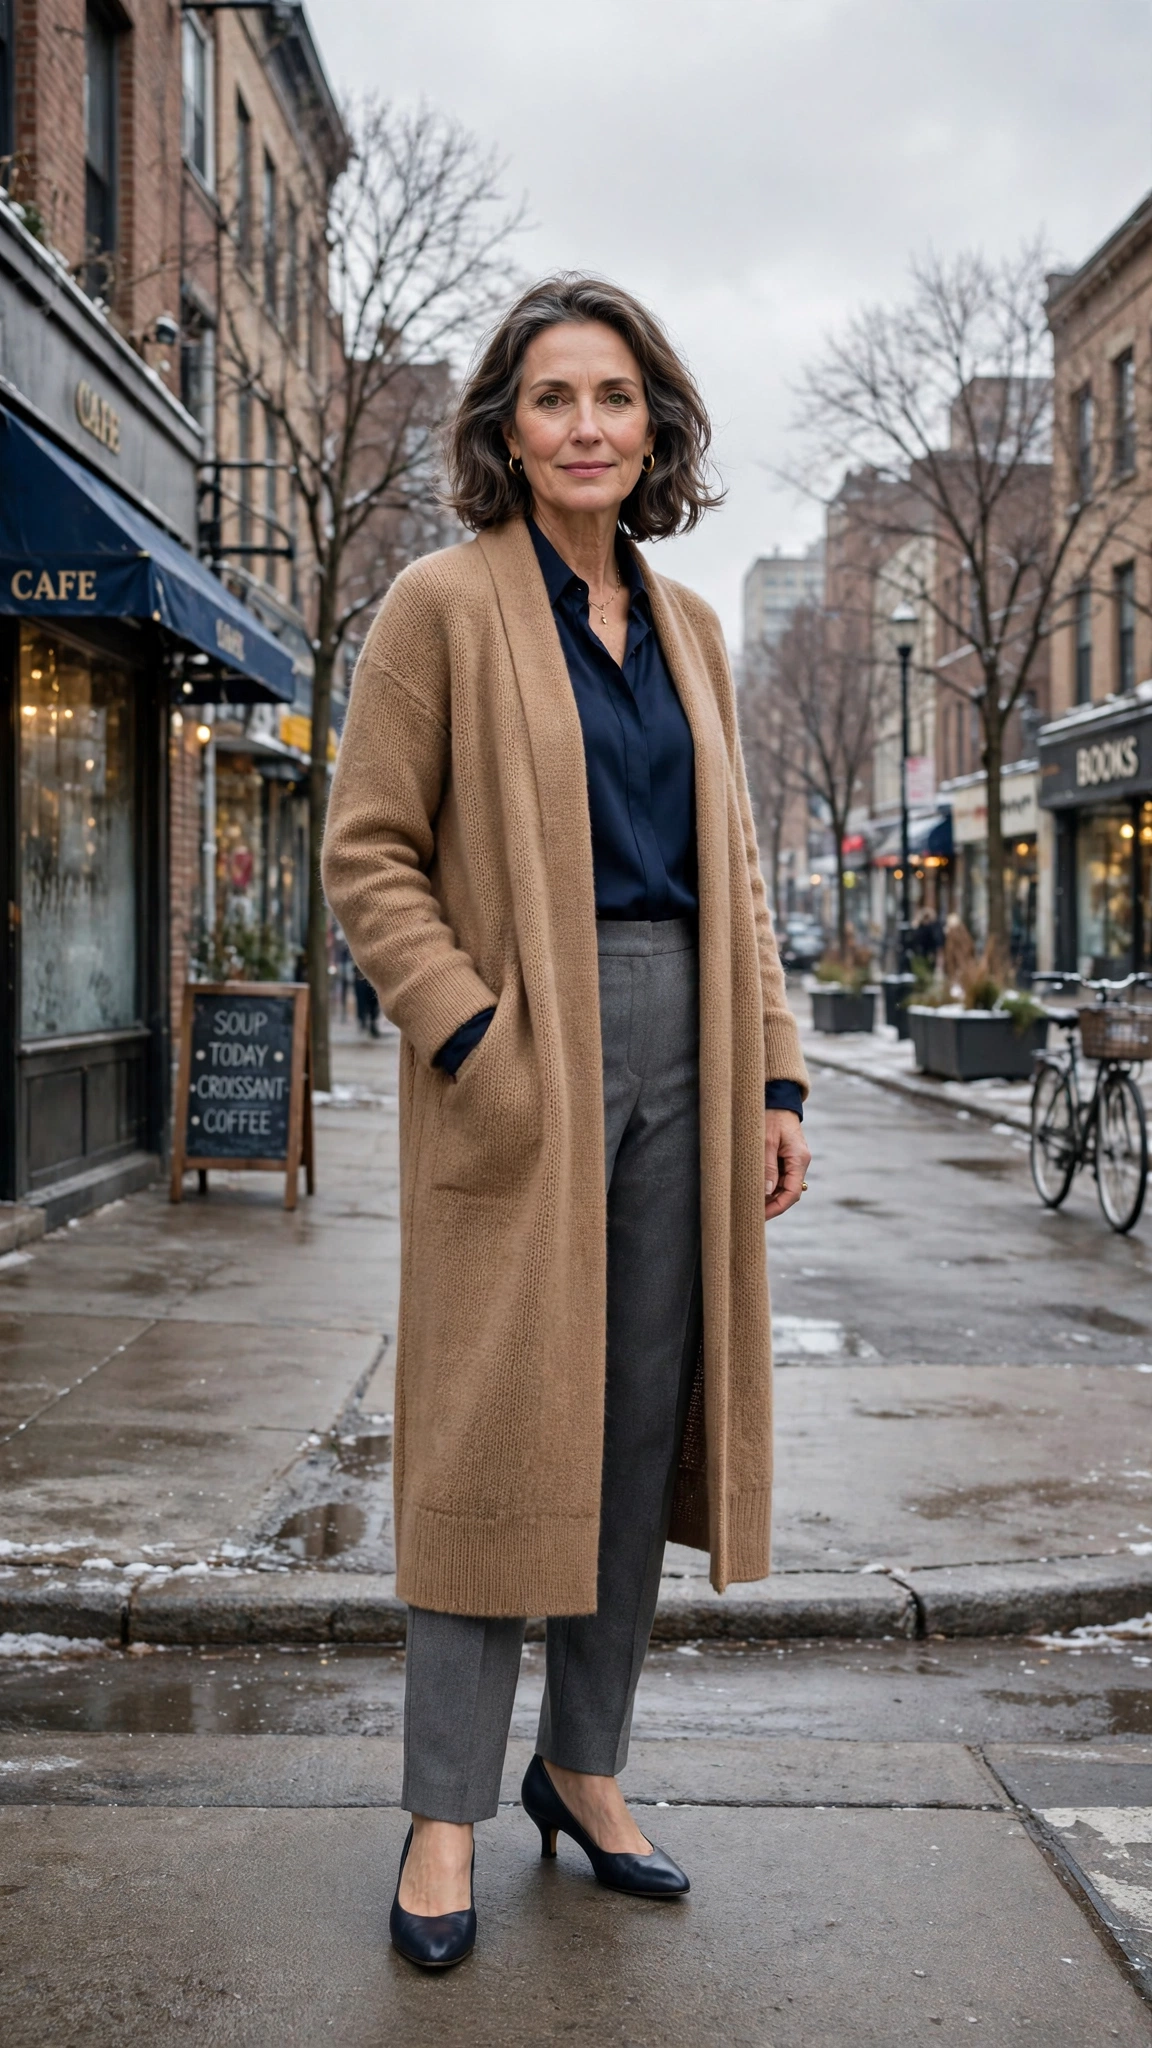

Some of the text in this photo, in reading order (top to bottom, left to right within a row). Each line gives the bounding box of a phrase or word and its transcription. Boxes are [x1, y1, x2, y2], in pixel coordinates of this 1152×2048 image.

[76, 381, 121, 454] CAFE
[11, 569, 97, 601] CAFE
[1076, 735, 1138, 787] BOOKS
[213, 1009, 269, 1036] SOUP
[208, 1041, 269, 1068] TODAY
[197, 1074, 286, 1100] CROISSANT
[203, 1107, 272, 1135] COFFEE
